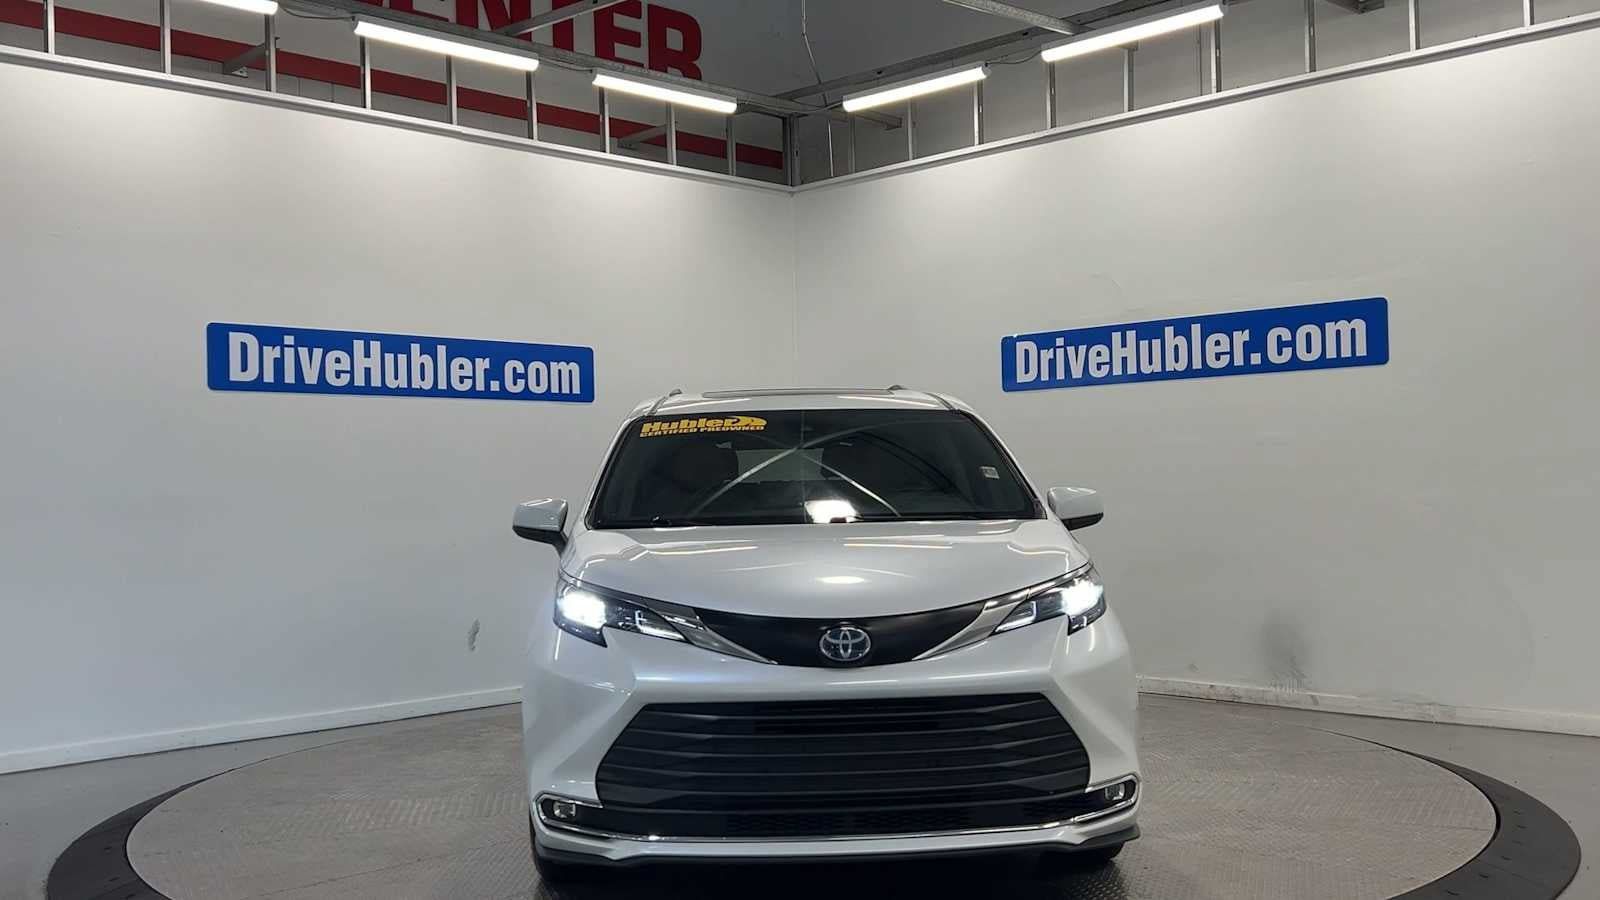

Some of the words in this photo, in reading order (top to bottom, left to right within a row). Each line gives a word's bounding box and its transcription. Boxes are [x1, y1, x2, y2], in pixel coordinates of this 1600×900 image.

[356, 0, 703, 80] NTER
[228, 331, 581, 394] DriveHubler.com
[1016, 317, 1367, 383] DriveHubler.com
[639, 427, 698, 438] CERTIFIED
[641, 418, 738, 433] Hubler
